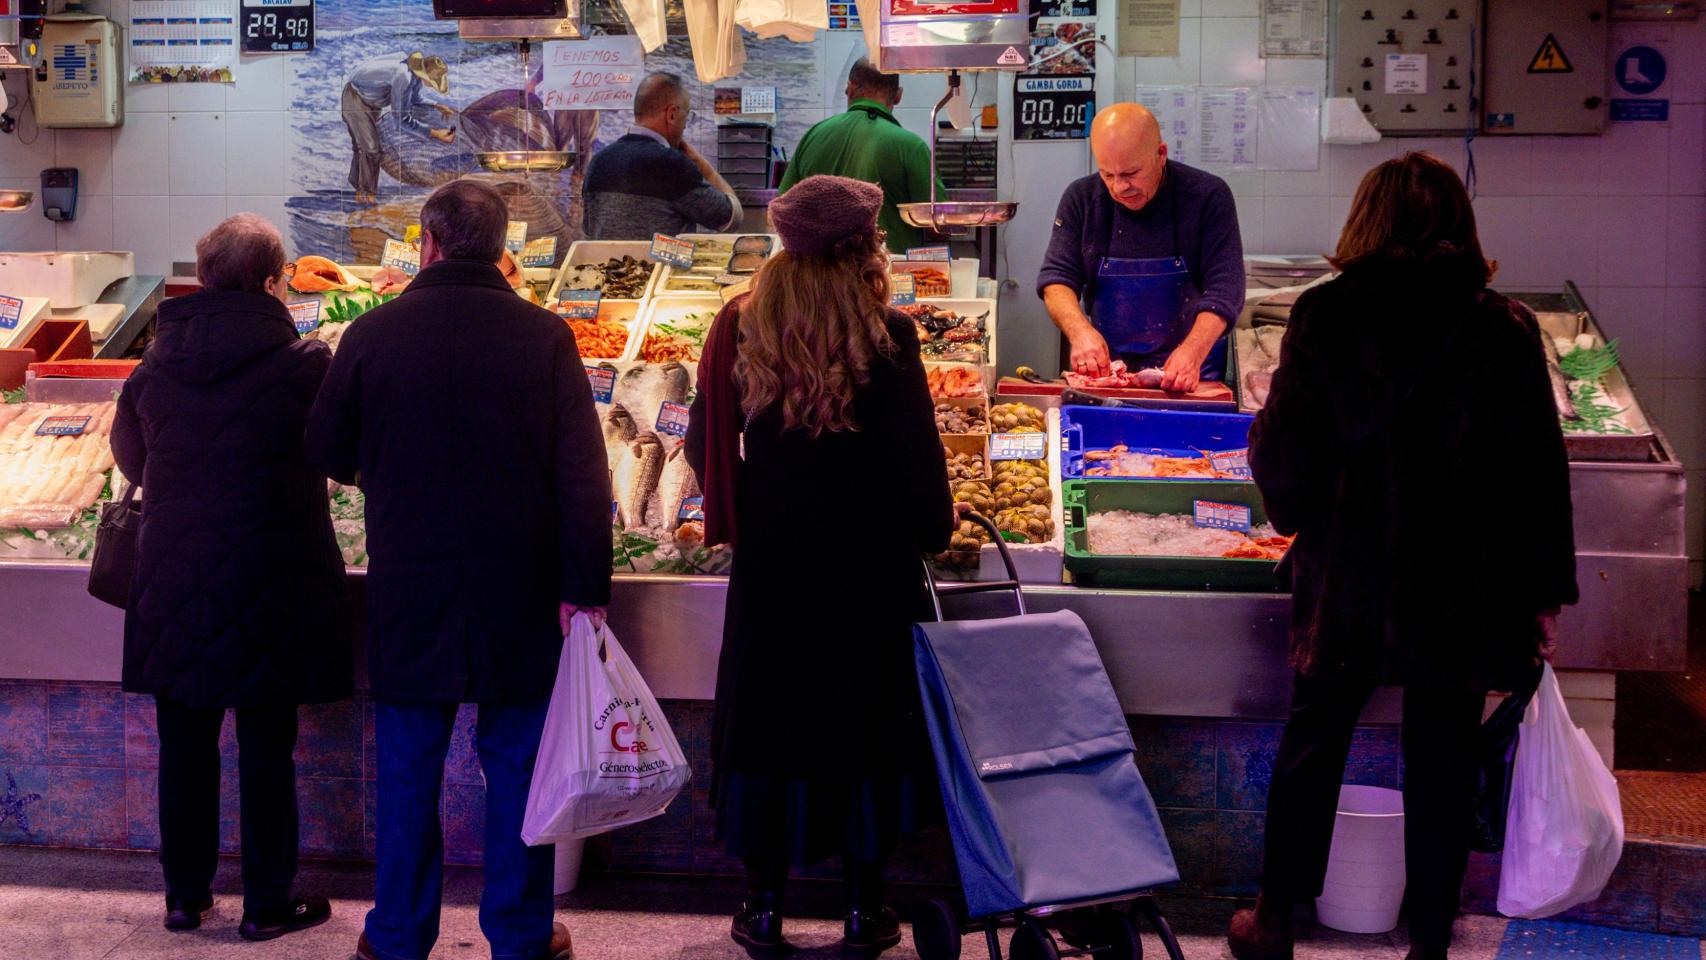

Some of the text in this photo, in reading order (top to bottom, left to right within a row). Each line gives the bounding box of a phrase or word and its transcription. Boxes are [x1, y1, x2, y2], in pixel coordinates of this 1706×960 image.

[248, 13, 309, 39] 29,90
[553, 45, 620, 63] TENEMOS
[571, 69, 601, 86] 100
[1026, 79, 1083, 90] GAMBA GORDA
[545, 90, 563, 106] EN
[567, 95, 580, 104] LA
